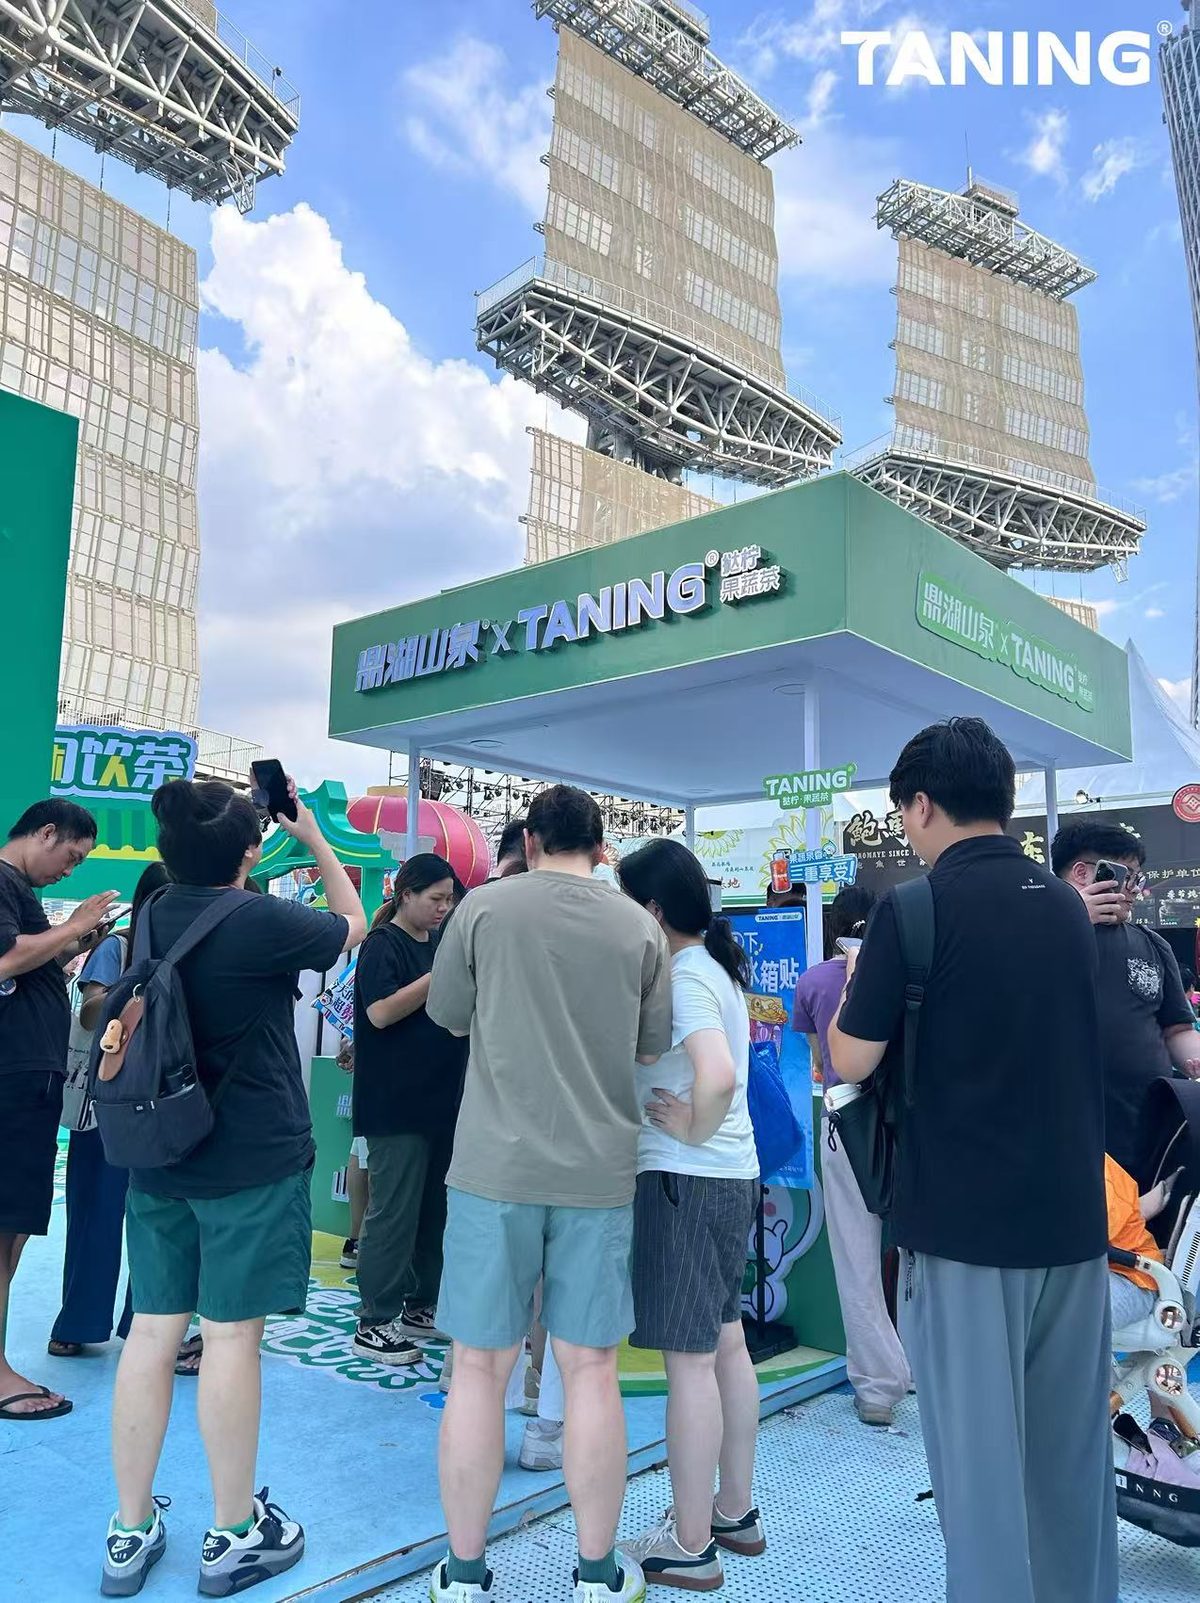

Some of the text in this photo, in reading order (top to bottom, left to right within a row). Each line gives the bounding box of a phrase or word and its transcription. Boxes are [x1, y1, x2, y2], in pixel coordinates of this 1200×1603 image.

[720, 566, 781, 603] 果蔬茶
[355, 620, 481, 692] 鼎湖山泉
[518, 563, 705, 651] TANING
[1011, 633, 1075, 693] TANING
[766, 771, 847, 796] TANING
[856, 851, 886, 859] AOMAYE
[889, 849, 910, 857] SINCE
[203, 1551, 215, 1559] AIR
